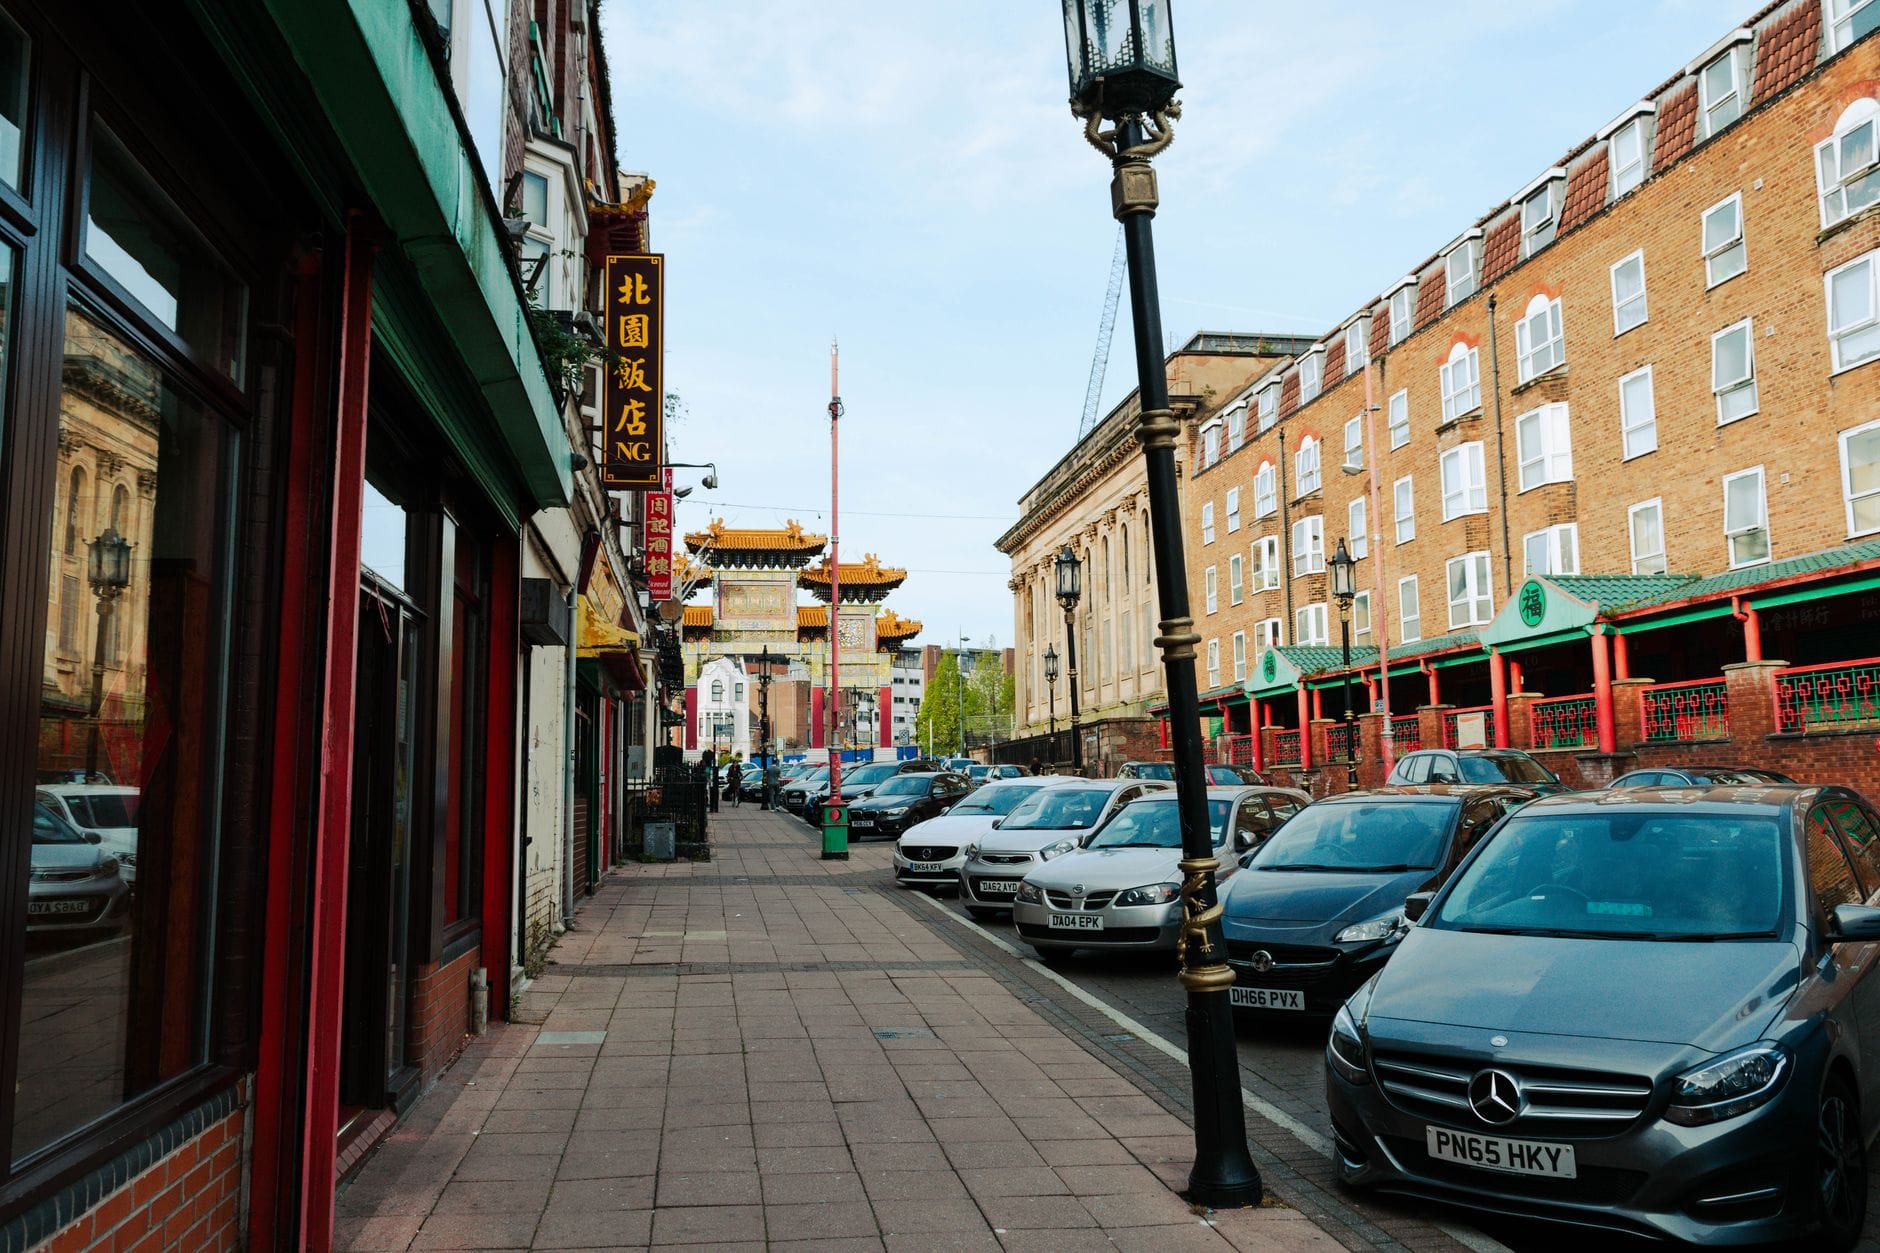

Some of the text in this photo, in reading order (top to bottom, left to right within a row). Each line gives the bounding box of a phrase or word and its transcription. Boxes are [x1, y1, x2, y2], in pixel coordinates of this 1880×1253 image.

[613, 272, 652, 436] 北園飯店
[615, 441, 652, 462] NG
[646, 497, 671, 577] 周記酒樓
[1522, 588, 1543, 620] 福
[983, 881, 1018, 892] DA62 AYD
[1052, 915, 1099, 928] DA04 EPK
[1232, 988, 1299, 1008] DH66 PVX
[1436, 1130, 1562, 1172] PN65 HKY
